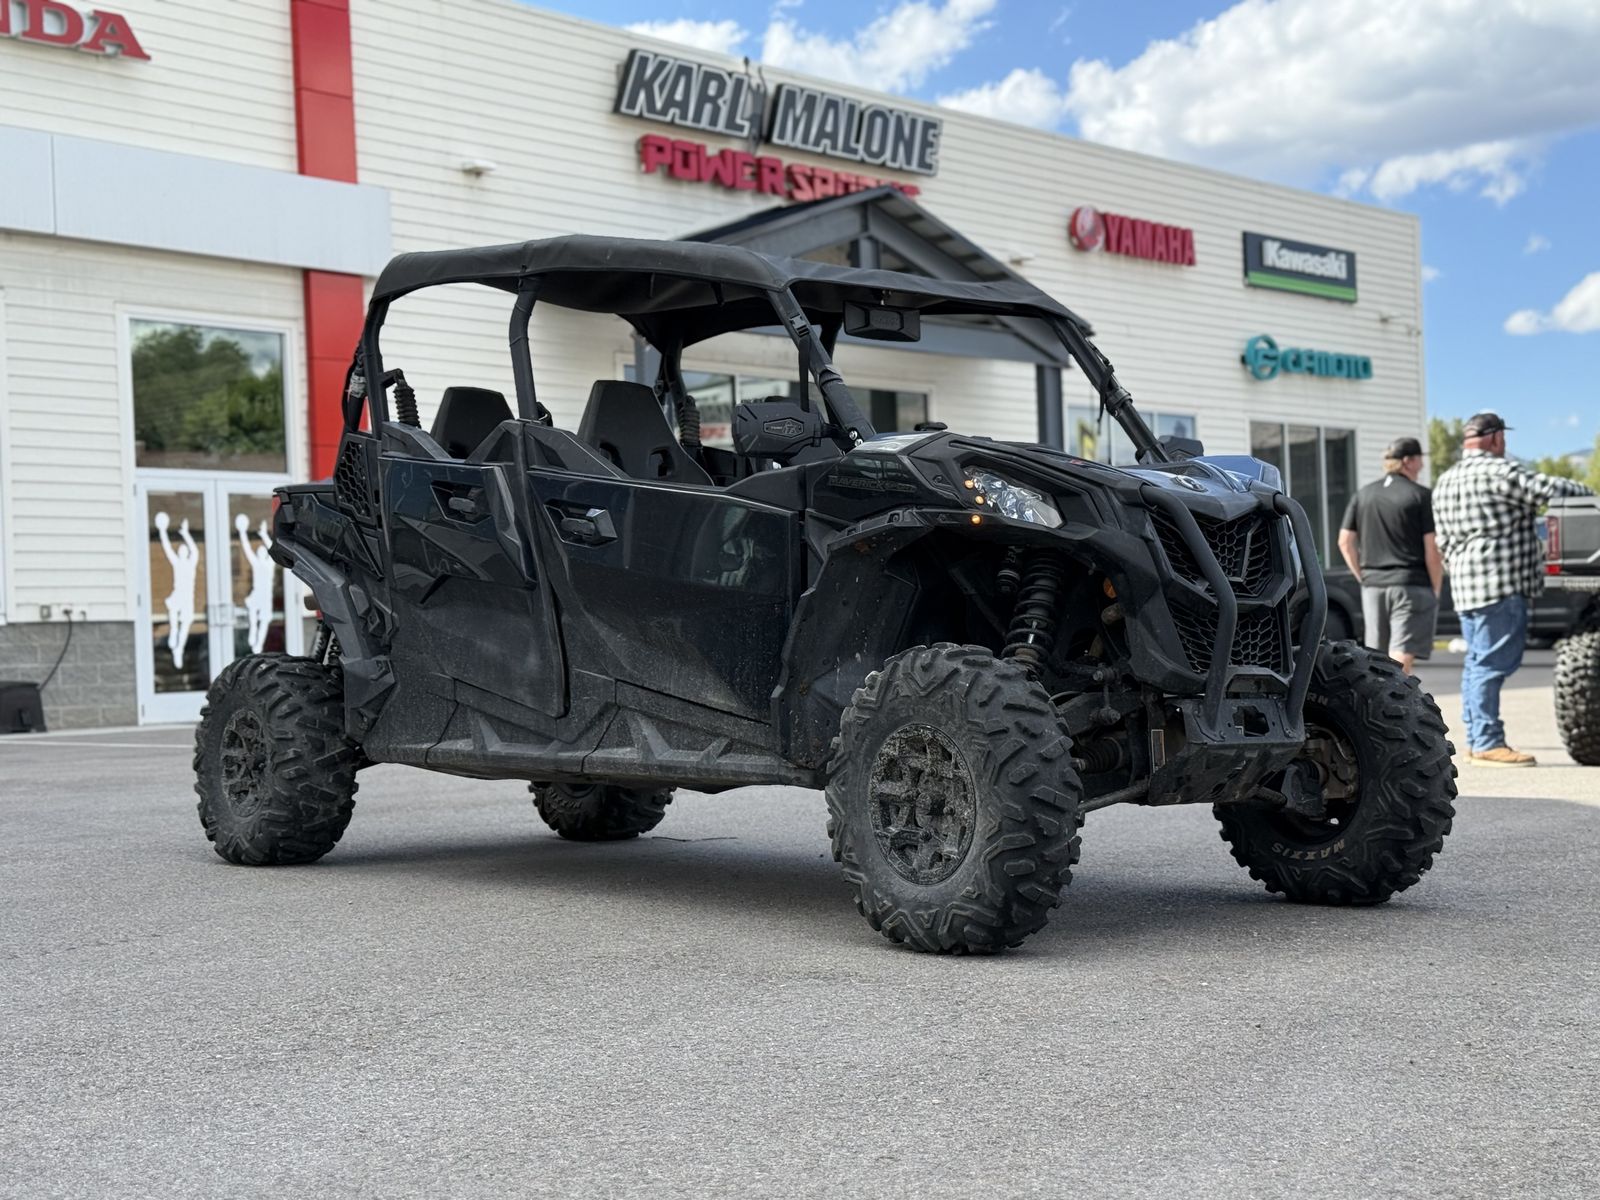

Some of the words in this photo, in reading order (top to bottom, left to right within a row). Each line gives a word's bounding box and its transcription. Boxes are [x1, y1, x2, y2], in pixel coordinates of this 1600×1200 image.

[621, 54, 749, 134] KARL
[774, 86, 939, 174] MALONE
[1103, 213, 1197, 266] YAMAHA
[1262, 239, 1349, 279] Kawasaki
[1271, 838, 1346, 862] MAXXIS
